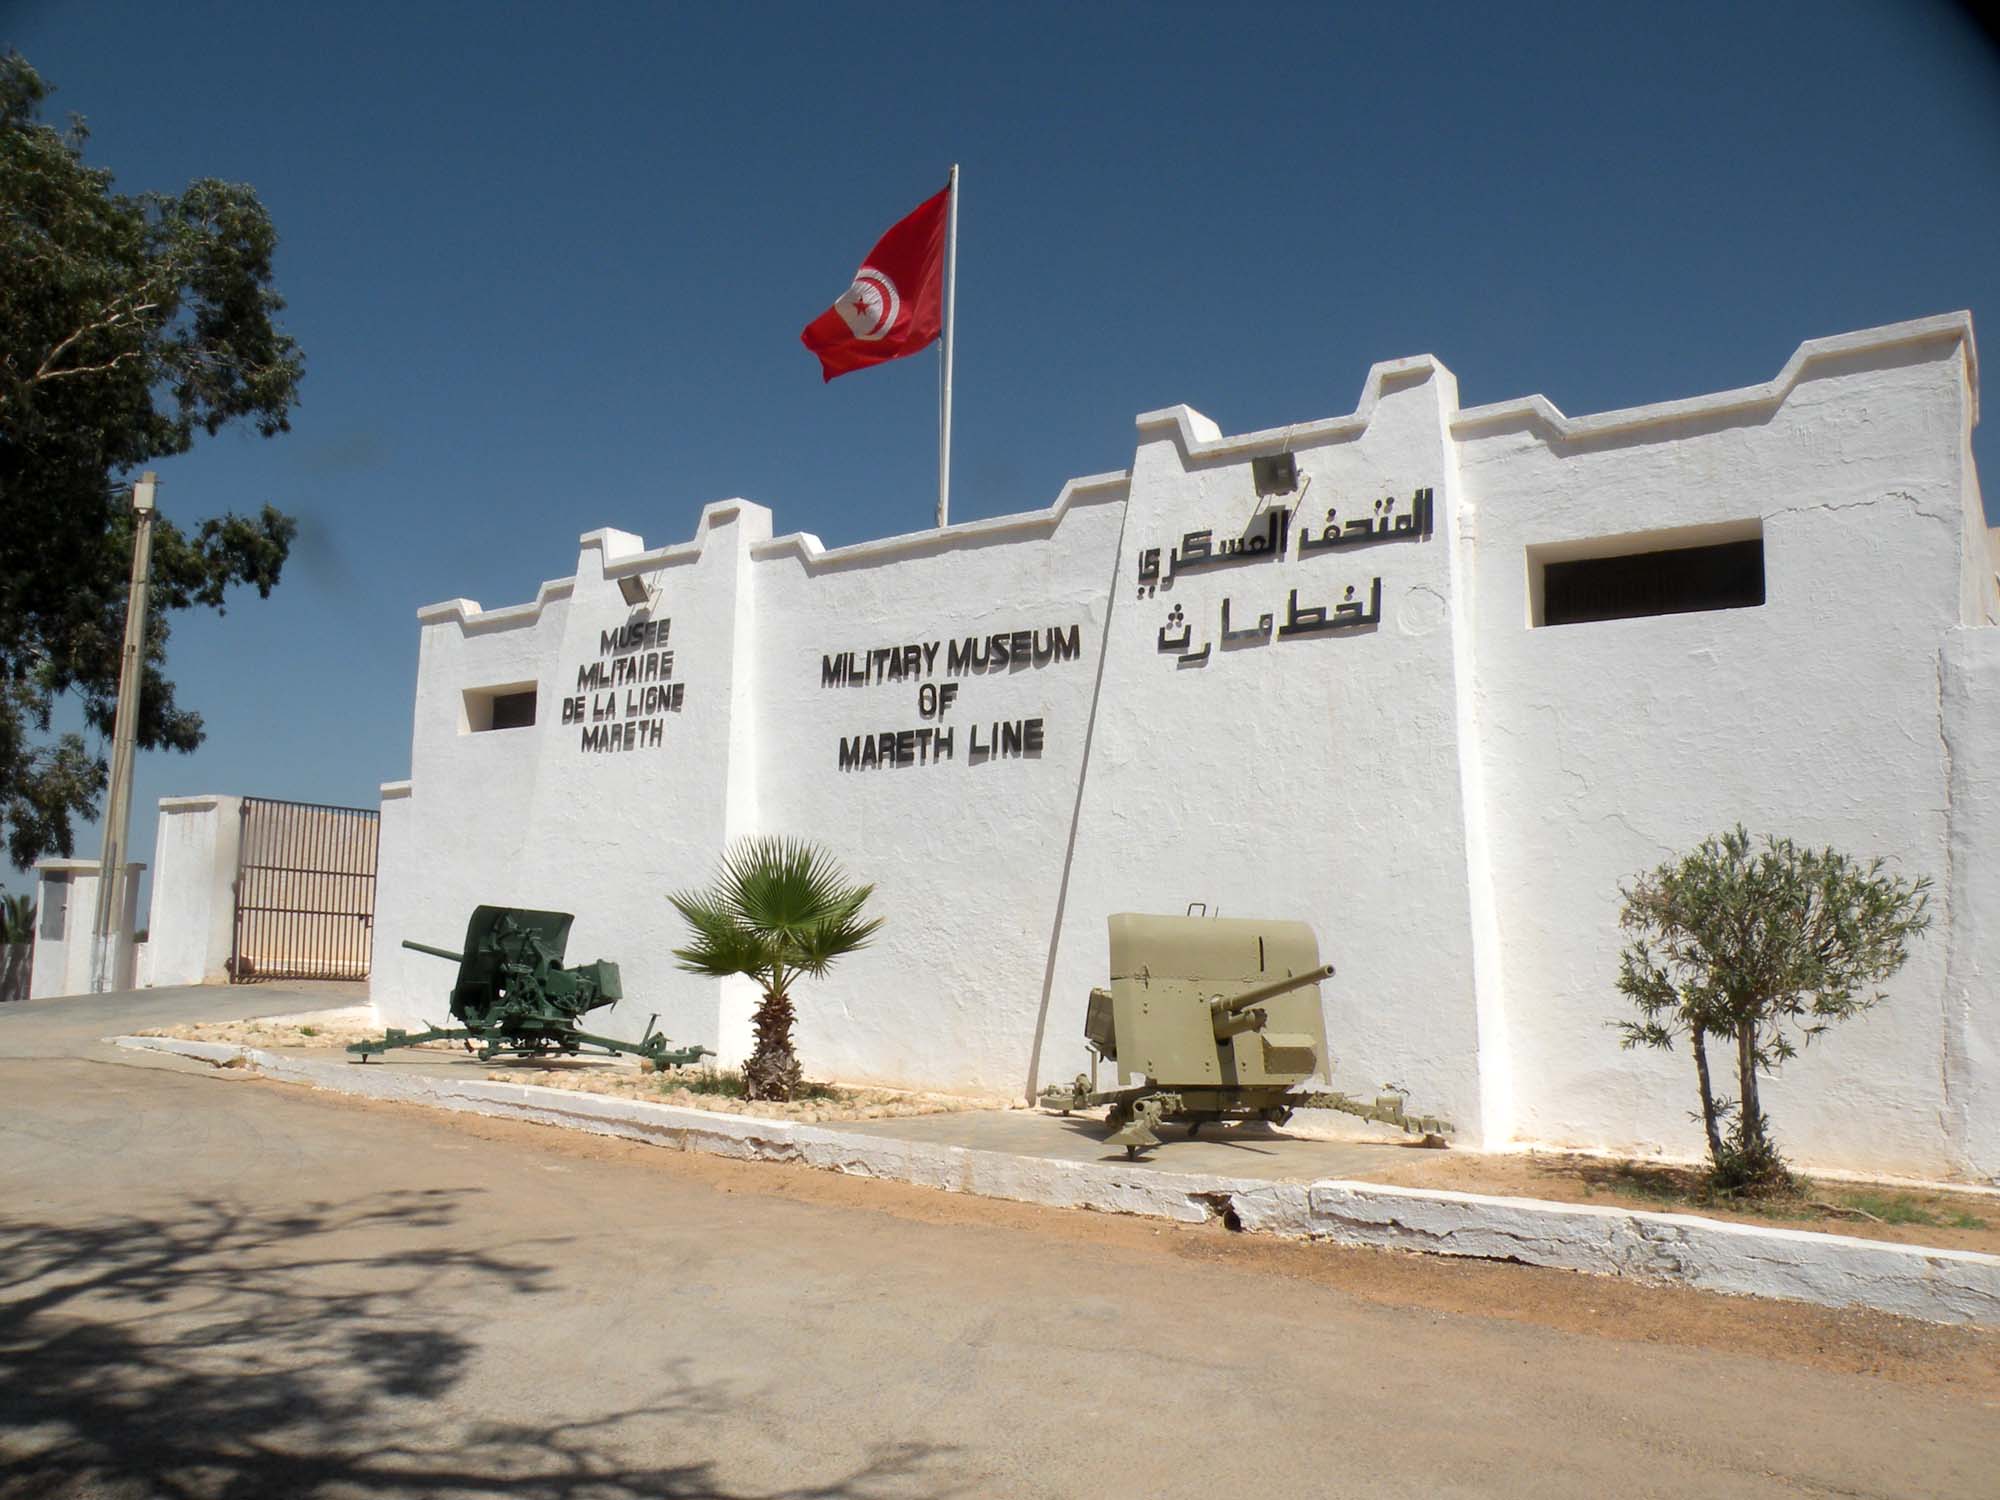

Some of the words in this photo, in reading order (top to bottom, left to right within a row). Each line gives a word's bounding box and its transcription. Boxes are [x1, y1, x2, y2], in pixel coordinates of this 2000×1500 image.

[1278, 576, 1381, 638] لخط
[600, 618, 671, 656] MUSEE
[821, 641, 941, 688] MILITARY
[947, 624, 1080, 676] MUSEUM
[577, 650, 674, 692] MILITAIRE
[562, 696, 586, 725] DE
[592, 692, 616, 722] LA
[626, 683, 685, 718] LIGNE
[918, 683, 958, 721] OF
[581, 718, 664, 753] MARETH
[838, 726, 954, 772] MARETH
[968, 718, 1044, 765] LINE
